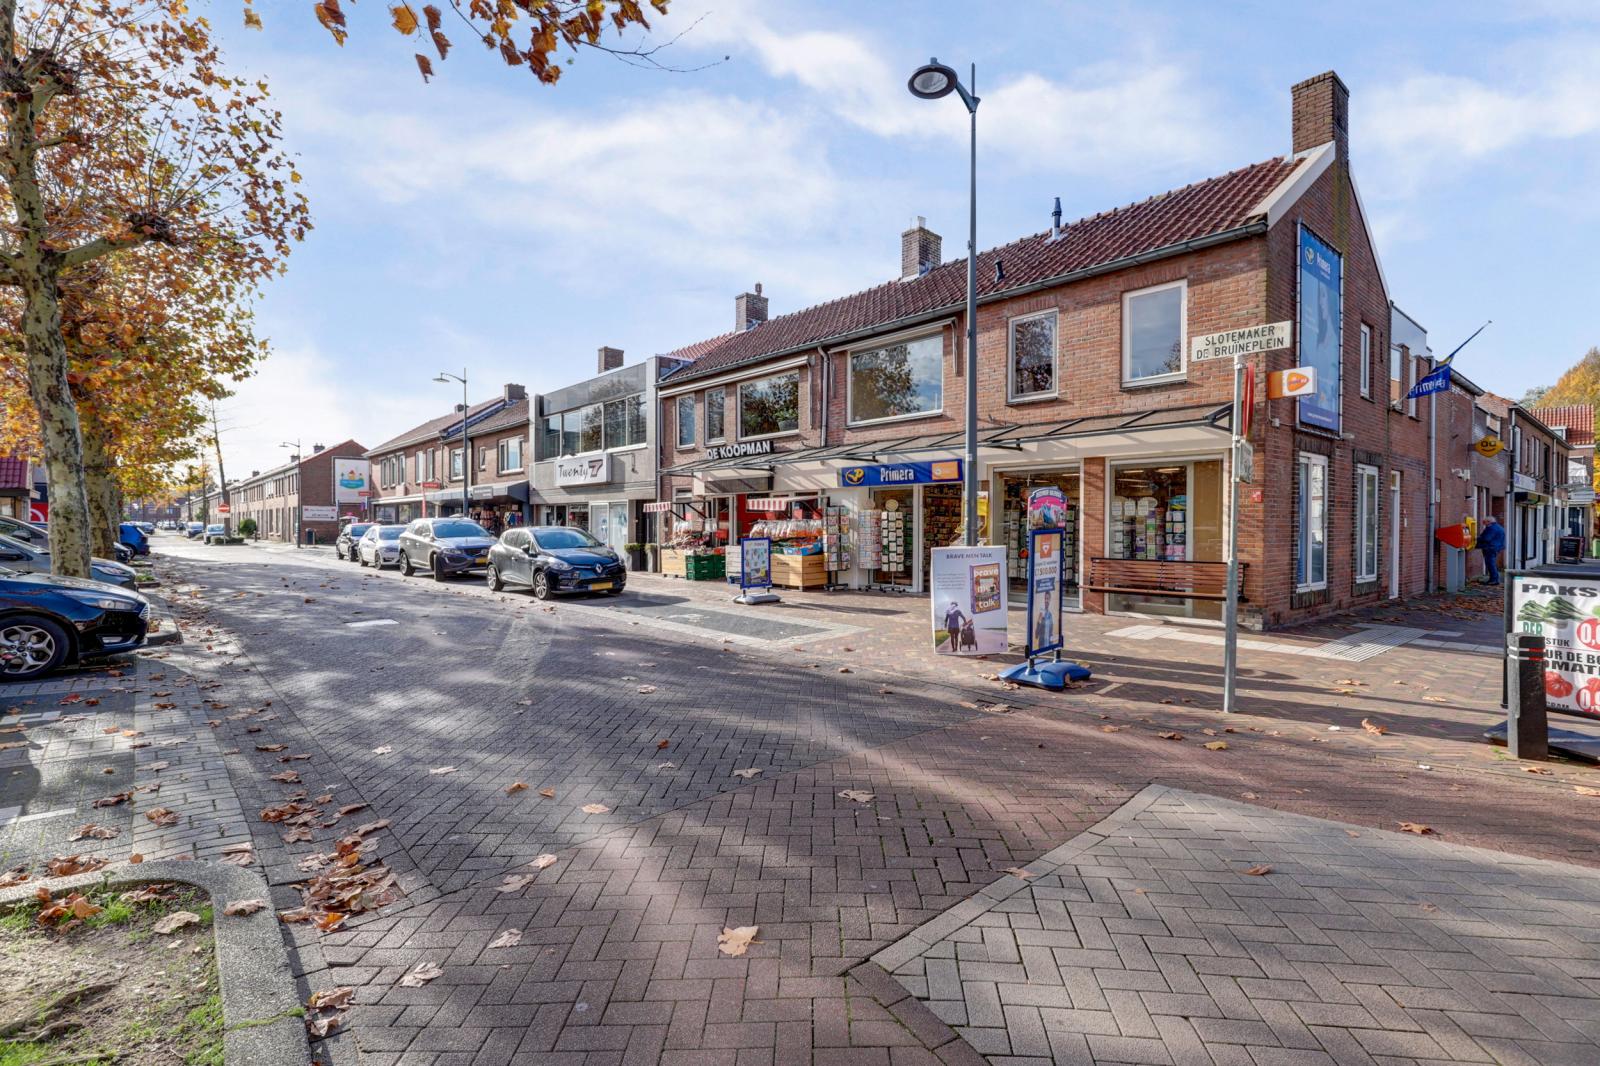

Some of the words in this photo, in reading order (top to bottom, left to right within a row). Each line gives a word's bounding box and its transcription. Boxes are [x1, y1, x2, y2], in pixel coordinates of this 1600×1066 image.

[1205, 325, 1275, 346] SLOTEMAKER
[1196, 348, 1209, 360] DE
[1214, 336, 1284, 357] BRUÏNEPLEIN
[707, 448, 719, 460] DE
[720, 440, 770, 458] KOOPMAN
[880, 467, 915, 482] Primera
[1522, 583, 1598, 598] PAKS
[978, 599, 996, 609] talk
[1545, 637, 1570, 647] STUK
[1544, 649, 1563, 660] UR
[1566, 651, 1583, 663] DE
[1544, 660, 1600, 675] MAT
